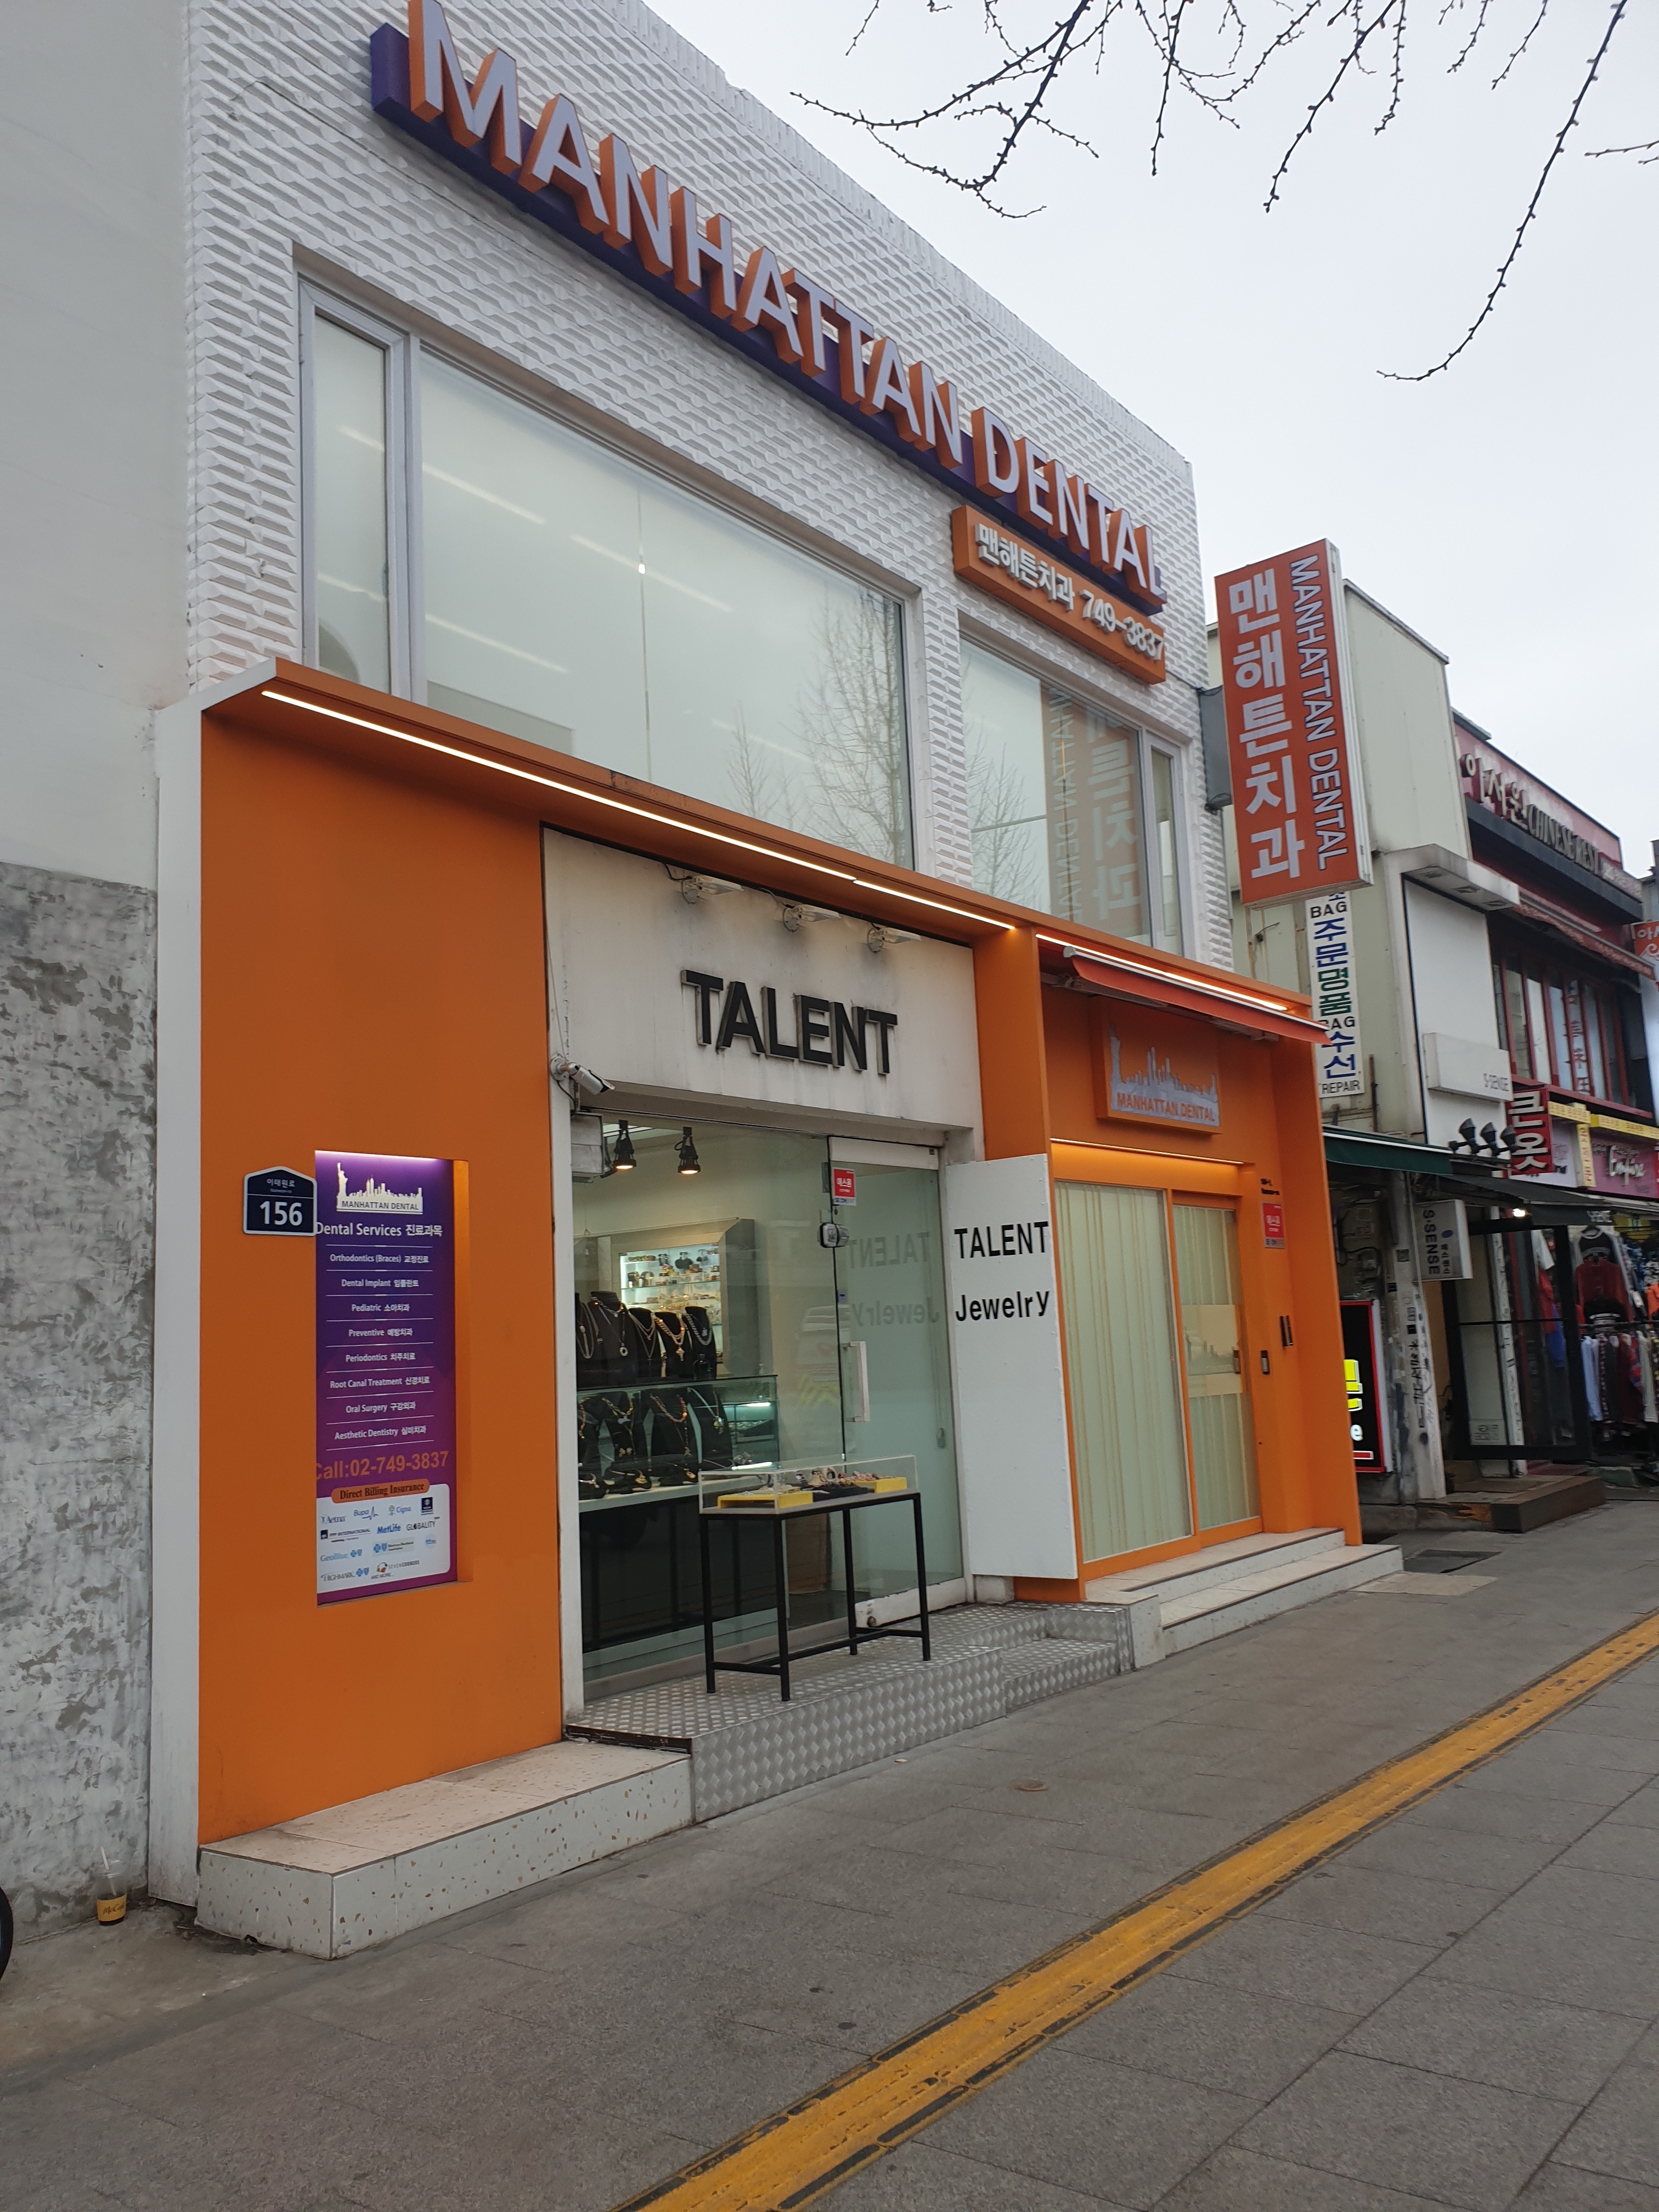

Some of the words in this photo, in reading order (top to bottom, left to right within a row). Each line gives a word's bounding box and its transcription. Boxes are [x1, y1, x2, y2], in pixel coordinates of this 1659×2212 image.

[409, 0, 963, 470] MANHATTAN
[972, 407, 1166, 604] DENTAL
[975, 523, 1074, 612] 맨해튼치과
[1079, 589, 1164, 661] 749-3837
[1290, 554, 1336, 742] MANHATTAN
[1228, 568, 1305, 878] 맨해튼치과
[1309, 748, 1348, 871] DENTAL
[1310, 901, 1347, 918] BAG
[680, 969, 898, 1074] TALENT
[1322, 1031, 1356, 1079] 수선
[1322, 1080, 1360, 1094] REPAIR
[1117, 1092, 1178, 1116] MANHATTAN
[1181, 1103, 1215, 1122] DENTAL
[266, 1179, 295, 1188] 이태원로
[259, 1201, 302, 1226] 156
[317, 1222, 353, 1235] Dental
[357, 1223, 402, 1236] Services
[406, 1224, 443, 1237] 진료과목
[954, 1221, 1048, 1259] TALENT
[376, 1255, 401, 1263] (Braces)
[365, 1279, 391, 1288] Implant
[956, 1291, 1049, 1321] Jewelry
[346, 1353, 387, 1362] Periodontics
[347, 1379, 366, 1387] Canal
[368, 1378, 402, 1386] Treatment
[346, 1404, 360, 1413] Oral
[362, 1403, 387, 1413] Surgery
[334, 1430, 366, 1440] Aesthetic
[368, 1428, 398, 1437] Dentistry
[340, 1490, 362, 1500] Direct
[365, 1487, 387, 1497] Billing
[390, 1483, 425, 1494] Insurance
[377, 1524, 401, 1534] MetLife
